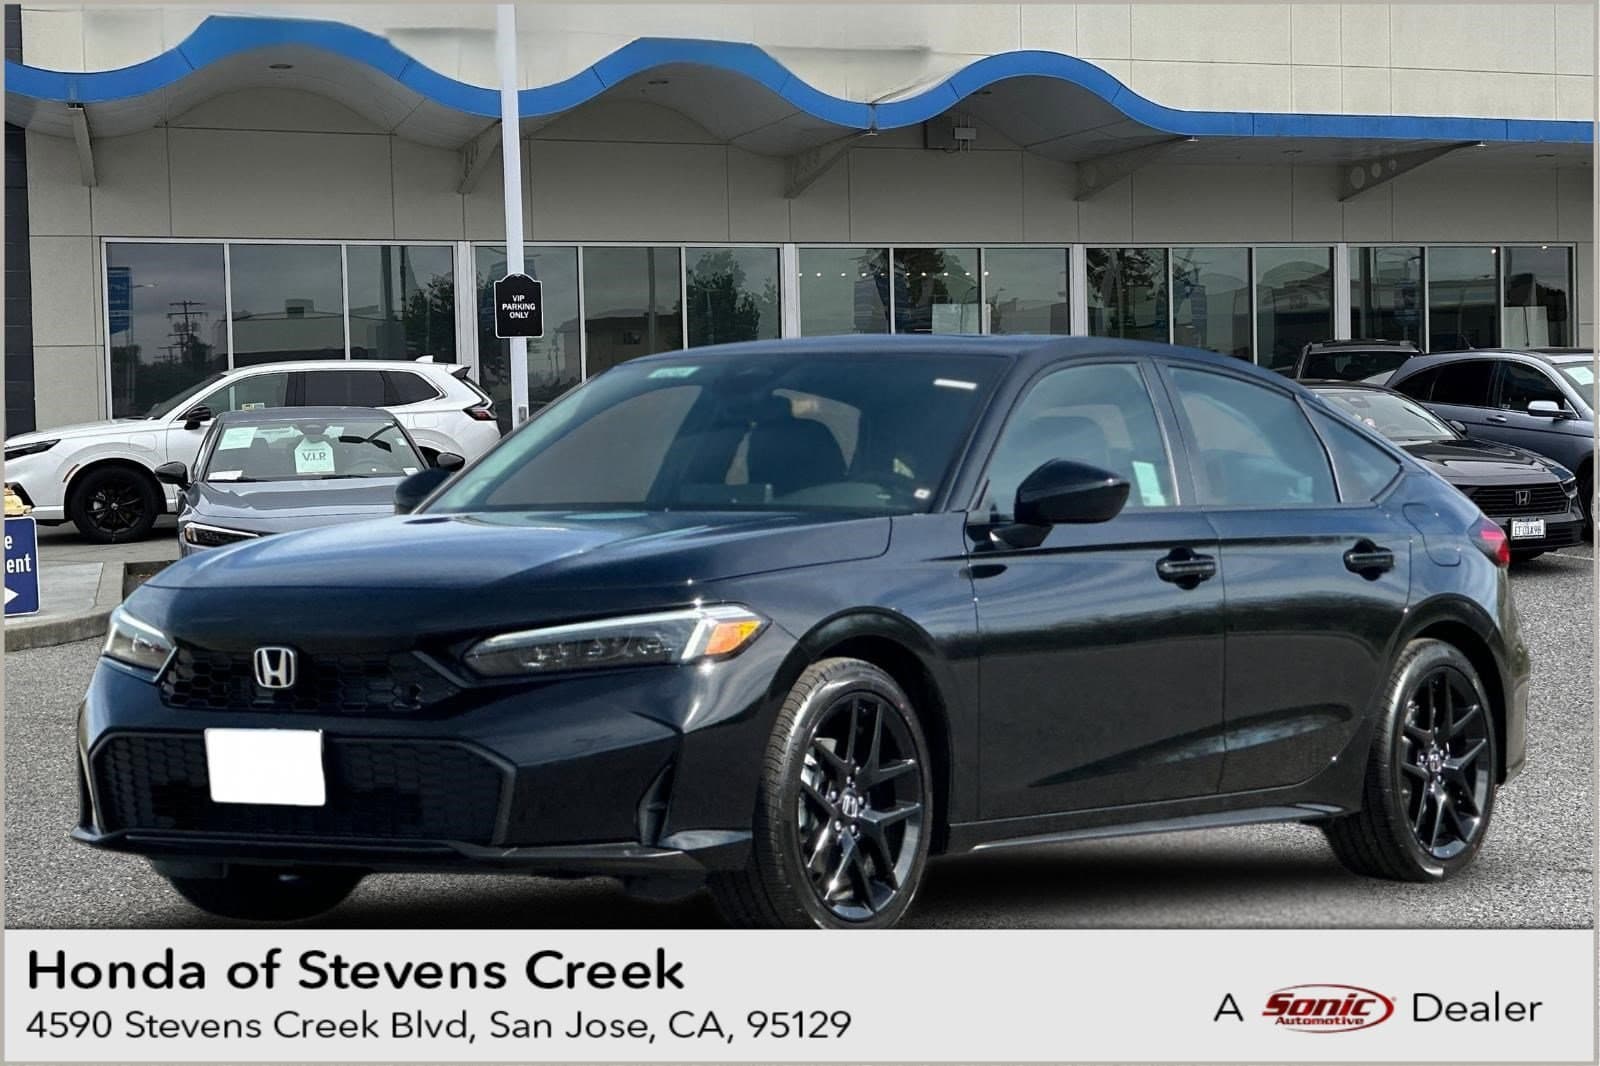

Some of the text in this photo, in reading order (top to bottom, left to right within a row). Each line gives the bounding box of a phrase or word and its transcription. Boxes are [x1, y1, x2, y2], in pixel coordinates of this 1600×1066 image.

[512, 294, 525, 302] VIP
[502, 303, 536, 311] PARKING
[509, 311, 529, 319] ONLY
